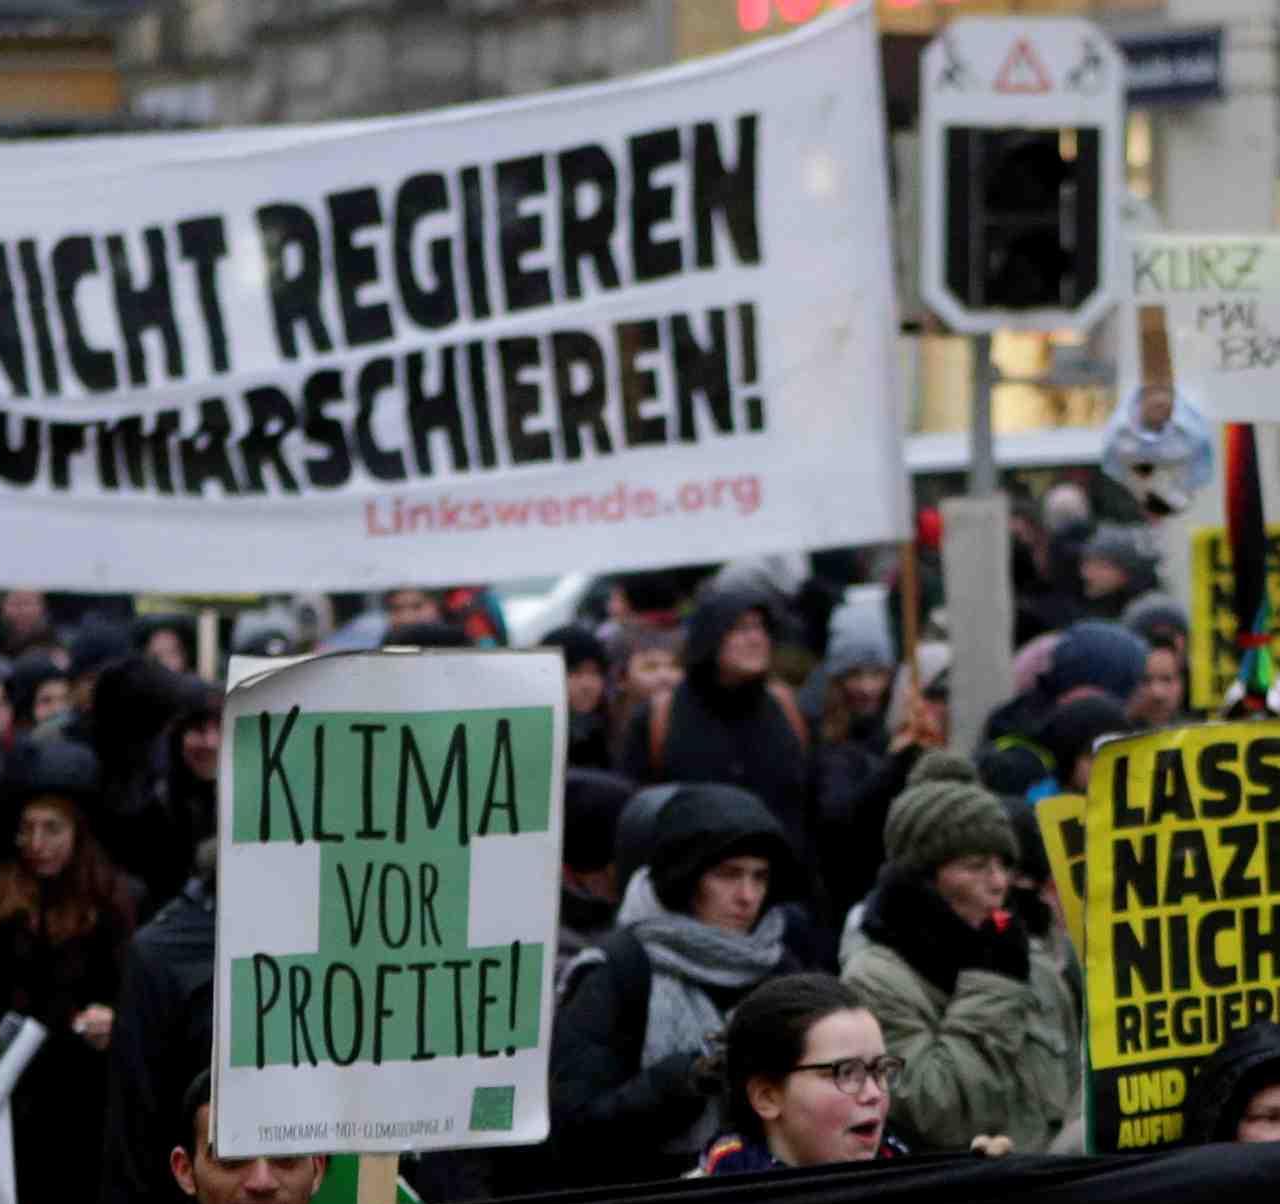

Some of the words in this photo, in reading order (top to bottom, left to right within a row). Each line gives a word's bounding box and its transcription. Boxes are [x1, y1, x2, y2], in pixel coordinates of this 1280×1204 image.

[255, 113, 763, 363] REGIEREN
[1129, 245, 1263, 294] KURZ
[1195, 302, 1260, 334] MAL
[363, 473, 763, 538] Linkswende.org
[257, 704, 521, 847] KLIMA
[336, 860, 443, 950] VOR
[252, 938, 523, 1071] PROFITE!
[1117, 1066, 1187, 1117] UND
